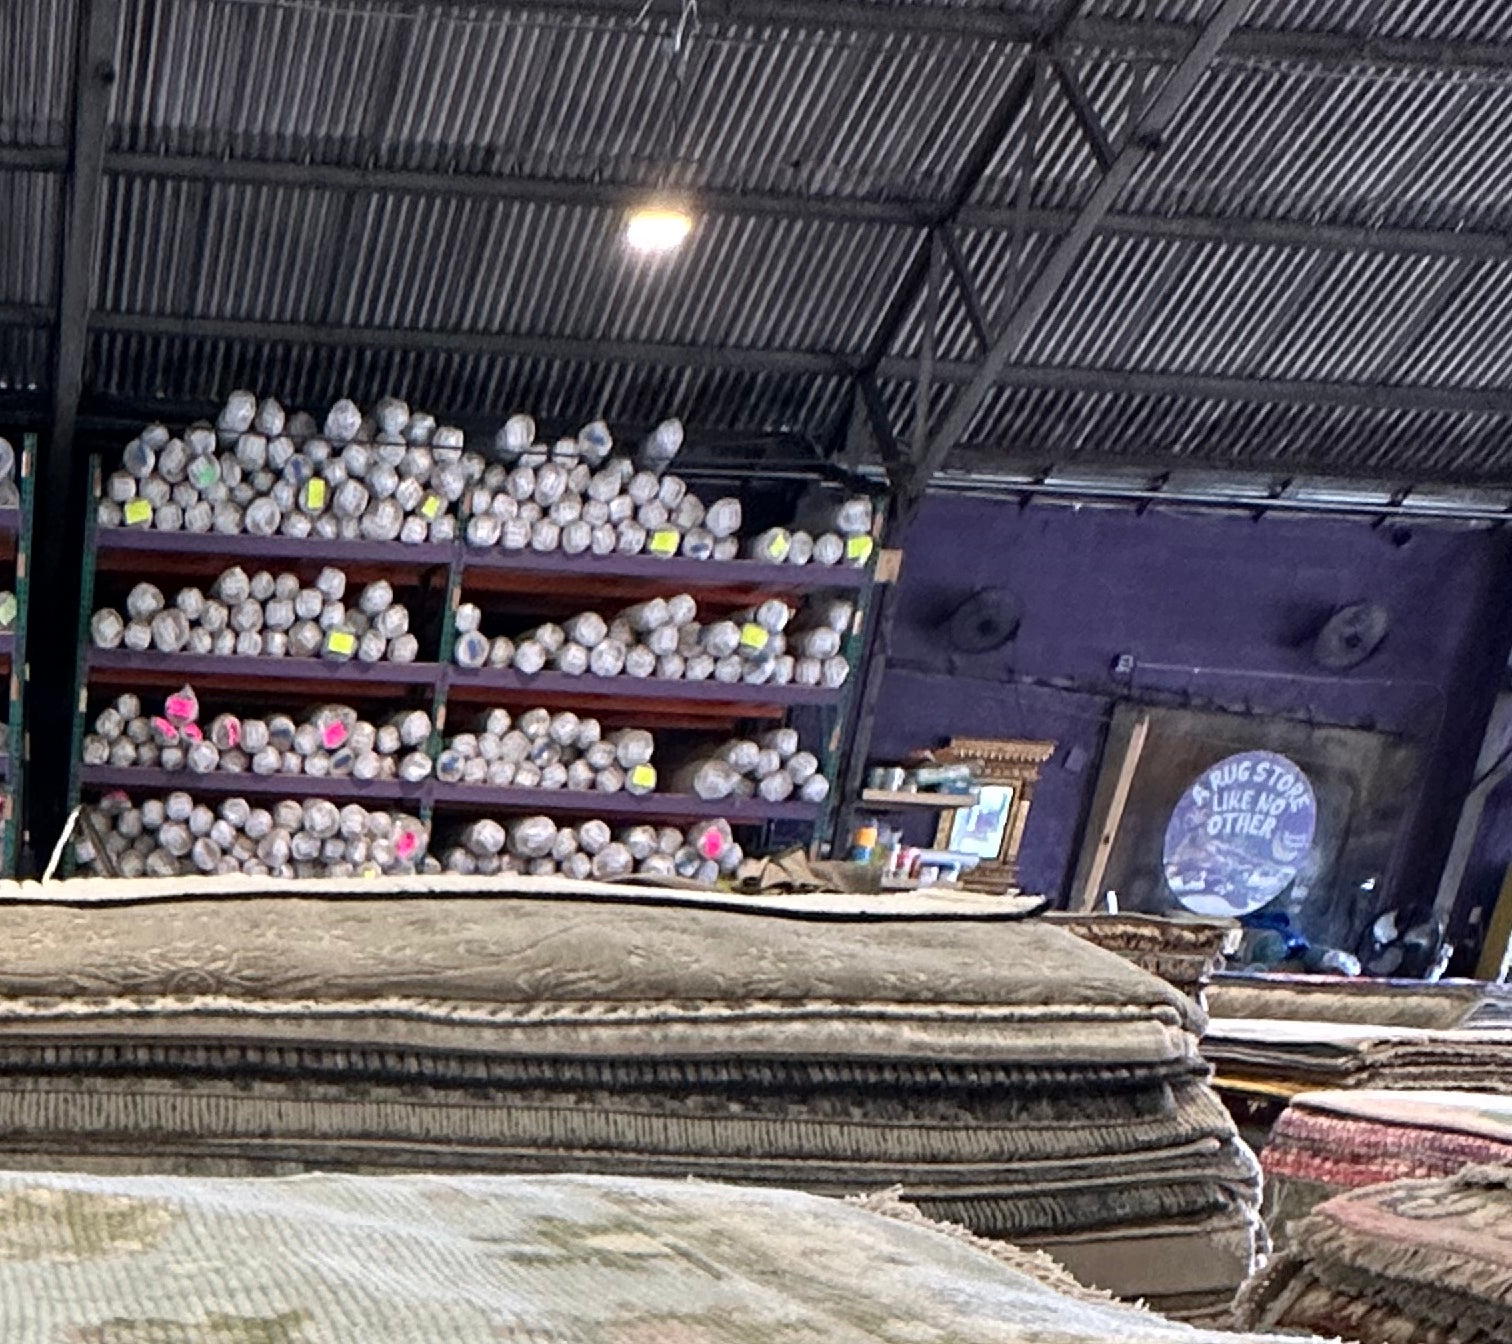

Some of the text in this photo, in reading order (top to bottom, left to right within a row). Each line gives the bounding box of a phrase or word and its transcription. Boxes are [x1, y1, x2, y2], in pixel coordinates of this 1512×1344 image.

[1192, 760, 1311, 813] A RUG STORE
[1211, 789, 1287, 816] LIKE NO
[1206, 812, 1278, 839] OTHER
